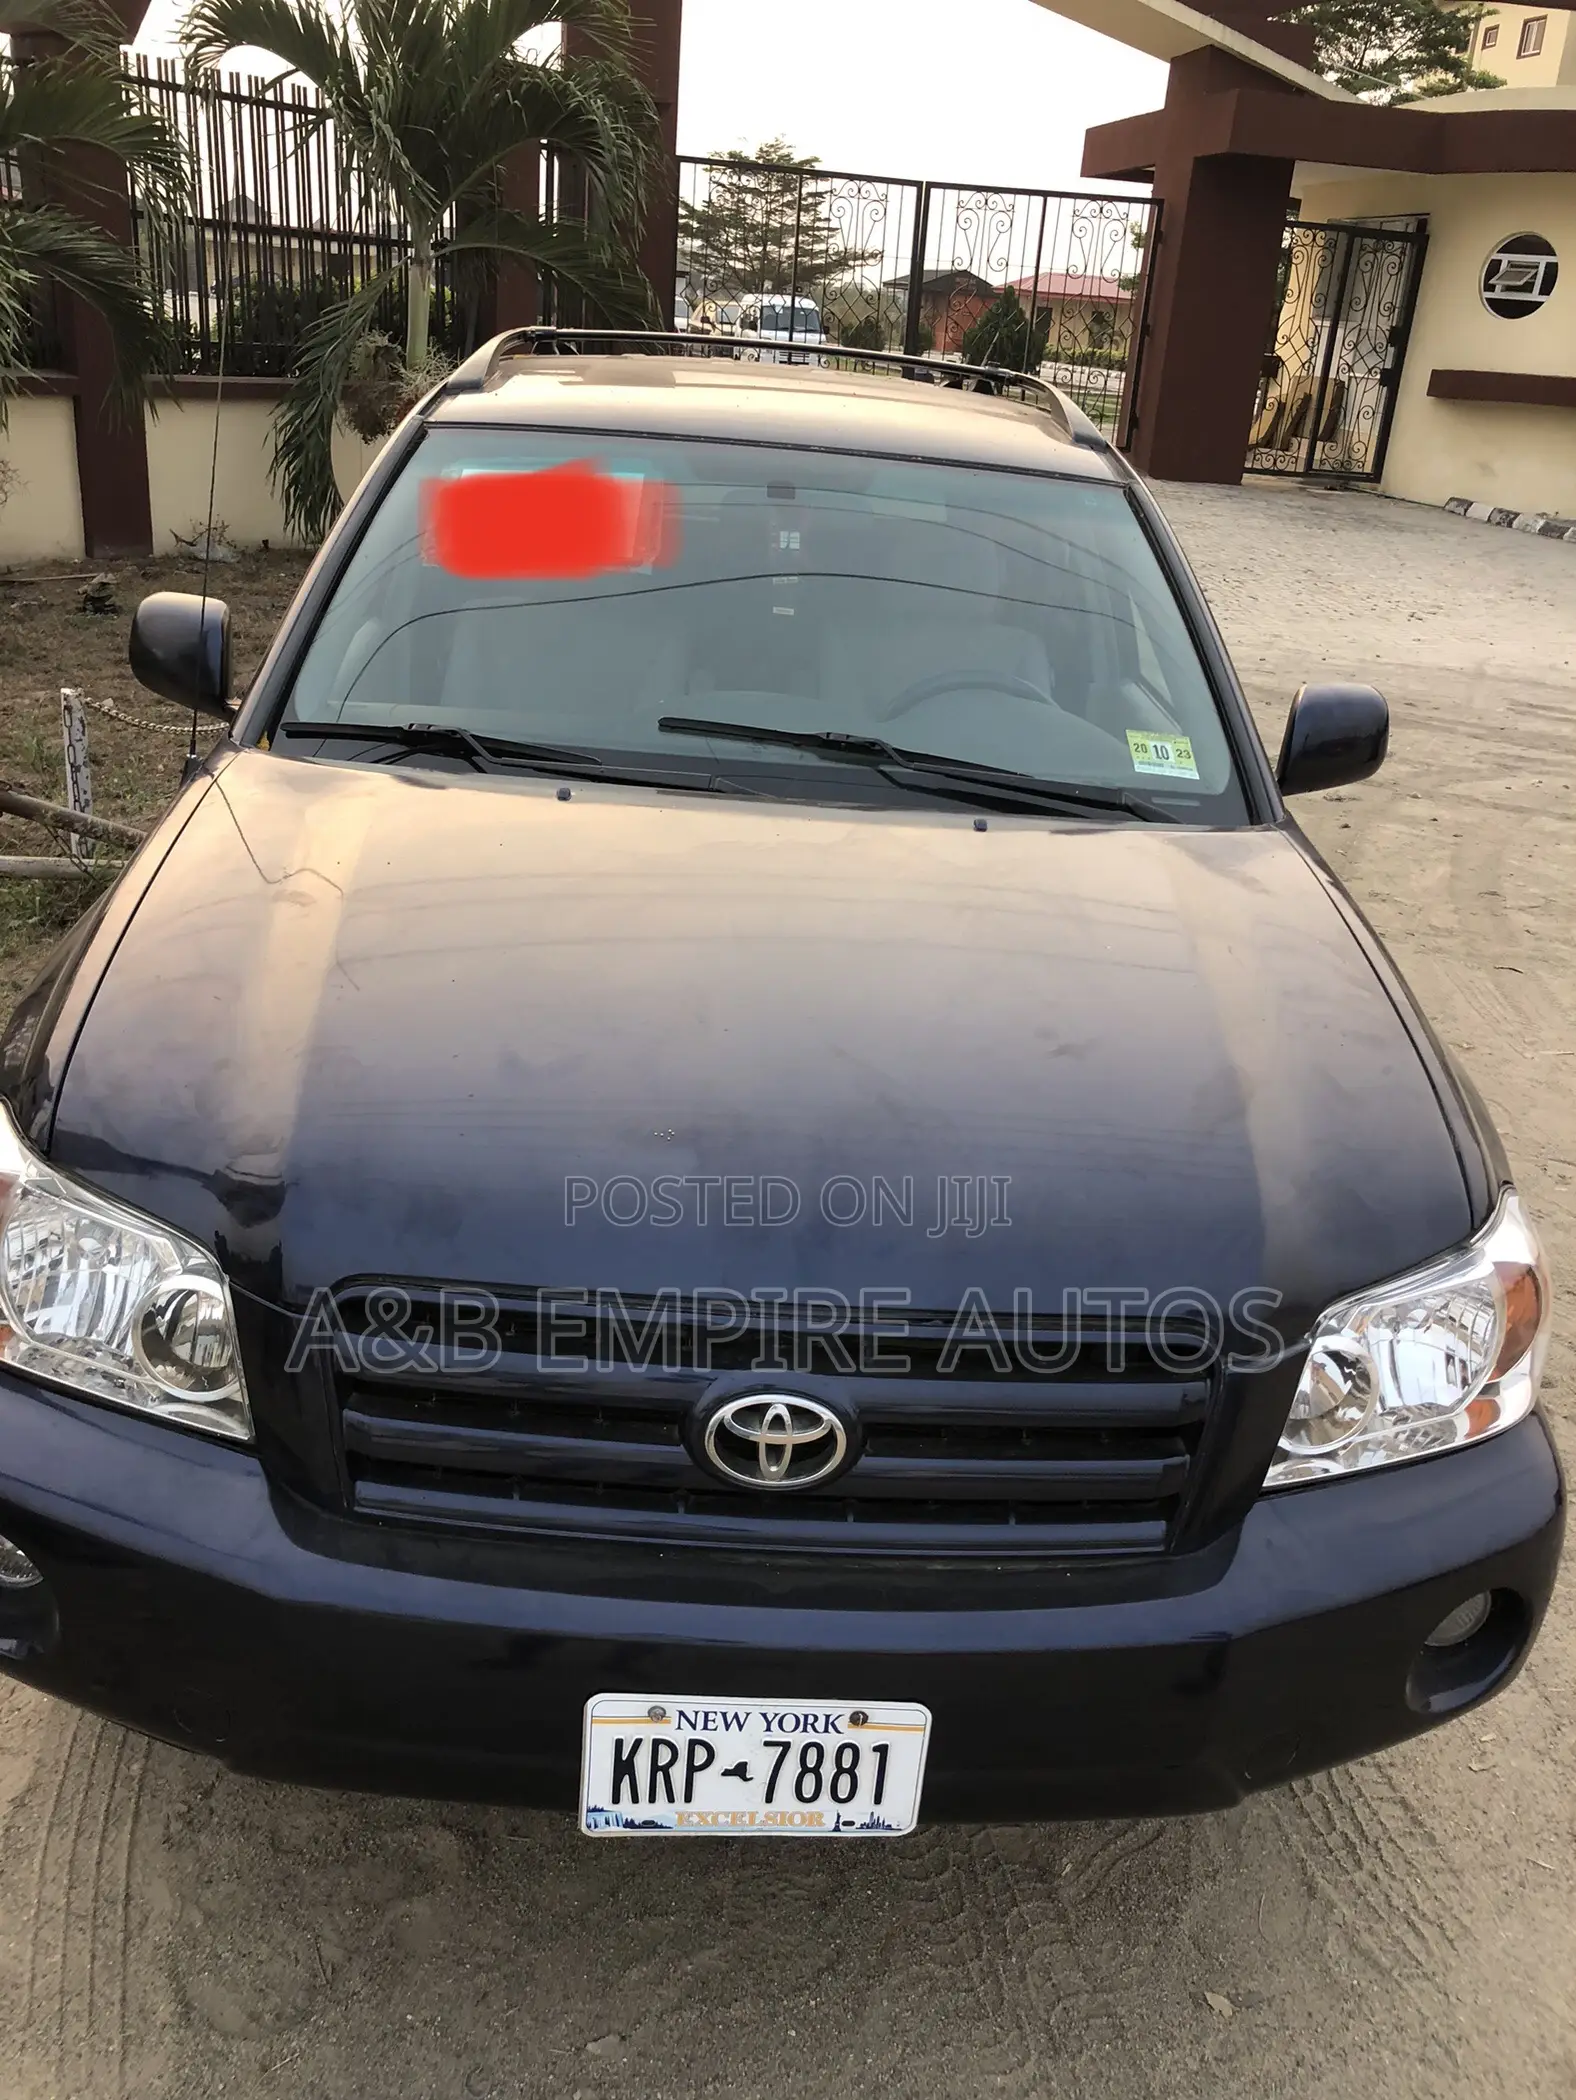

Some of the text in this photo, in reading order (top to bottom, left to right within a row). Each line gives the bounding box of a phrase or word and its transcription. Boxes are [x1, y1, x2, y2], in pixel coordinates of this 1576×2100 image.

[1133, 743, 1192, 761] 20 10 23
[675, 1709, 845, 1735] NEW YORK
[675, 1810, 827, 1828] EXCELSIOR
